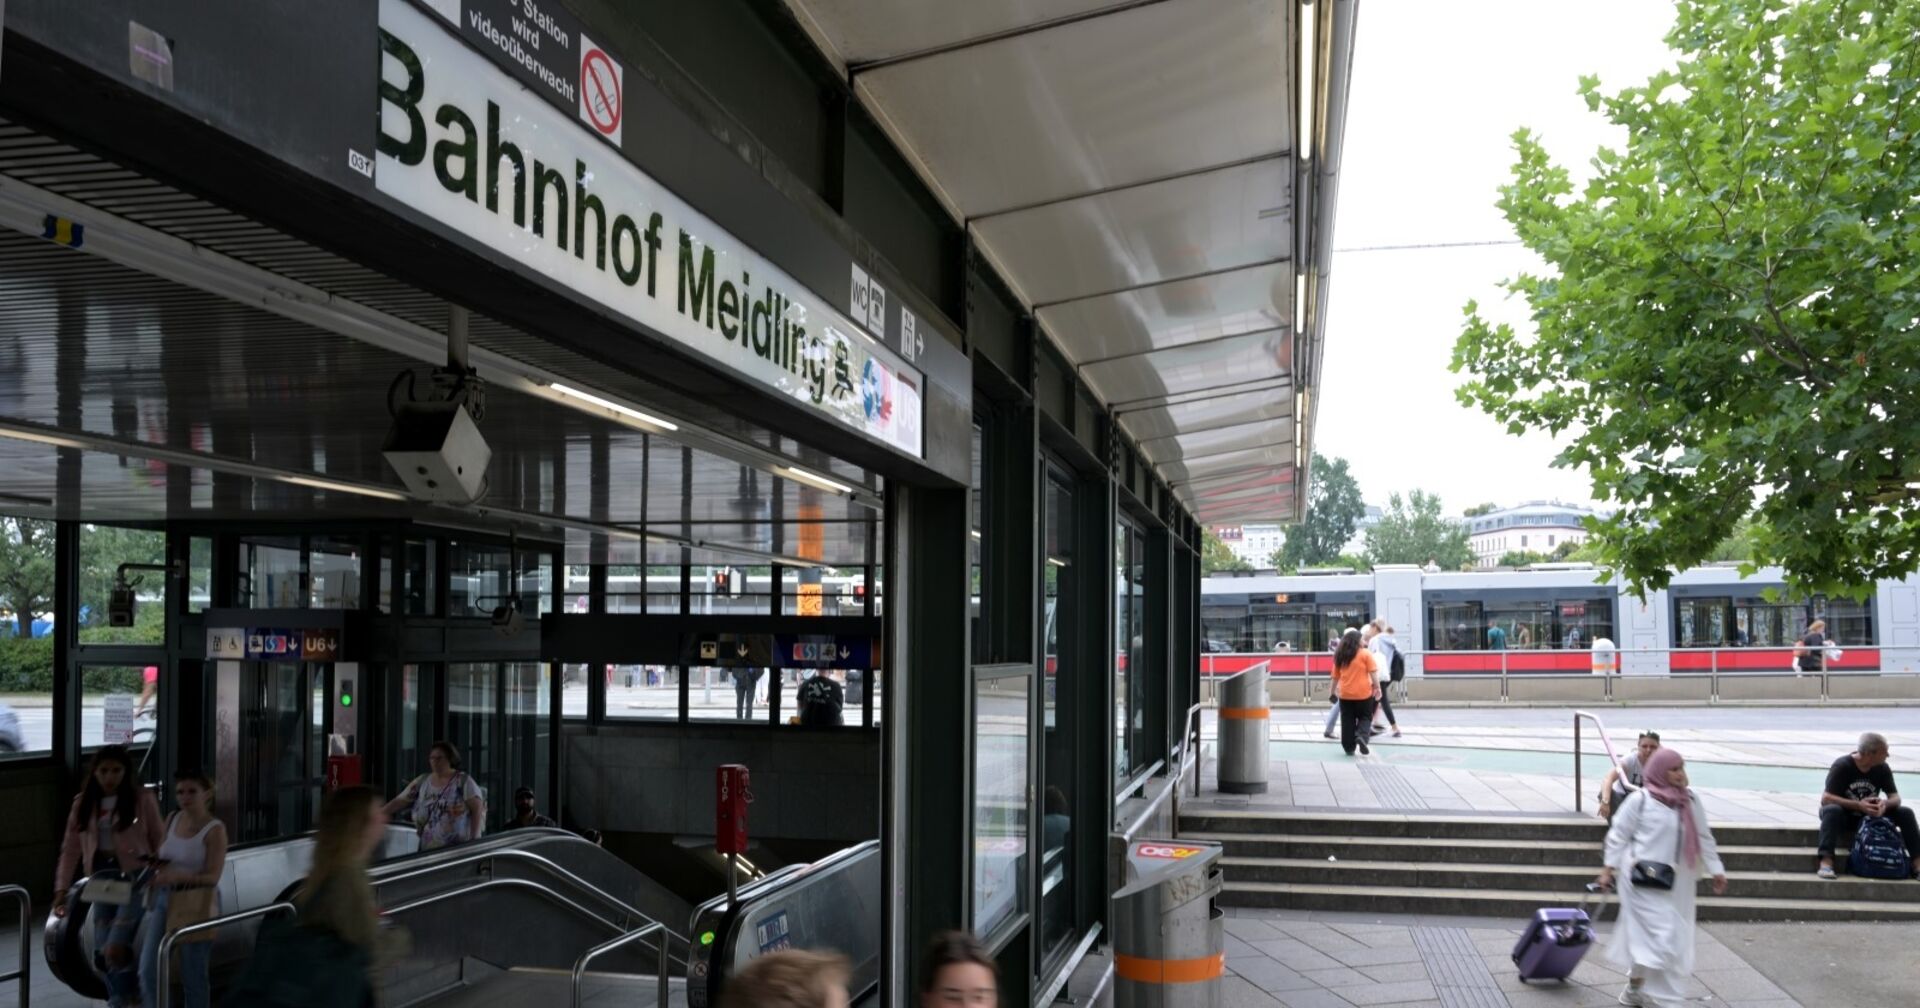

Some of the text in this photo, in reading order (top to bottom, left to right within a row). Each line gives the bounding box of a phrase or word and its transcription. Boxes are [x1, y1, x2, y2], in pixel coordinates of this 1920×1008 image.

[511, 16, 540, 51] wird
[523, 0, 569, 50] Station
[469, 9, 575, 103] videoüberwacht
[376, 26, 825, 404] Bahnhof Meidling
[852, 279, 867, 311] WC
[306, 637, 326, 652] U6
